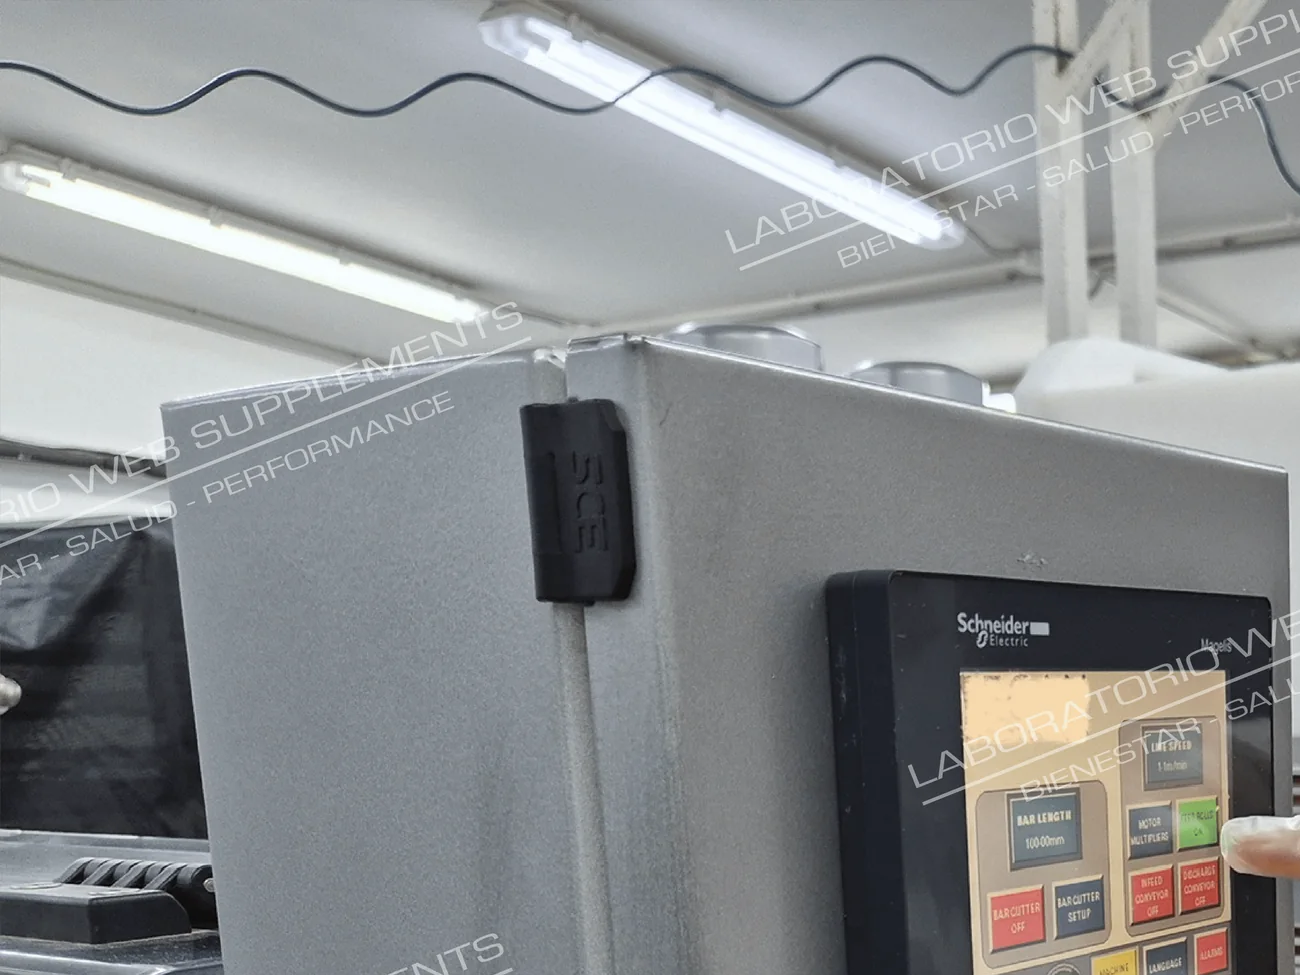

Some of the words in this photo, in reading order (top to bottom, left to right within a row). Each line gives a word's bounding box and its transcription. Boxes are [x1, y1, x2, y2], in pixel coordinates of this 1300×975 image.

[957, 612, 1030, 634] Schneider
[989, 634, 1028, 647] Electric
[1016, 814, 1036, 827] BAR
[1037, 809, 1072, 824] LENGTH
[1138, 817, 1161, 830] MOTOR
[1130, 830, 1169, 846] MULTIPLIERS
[1140, 875, 1163, 889] INFEED
[1183, 879, 1216, 895] CONVEYOR
[1135, 889, 1169, 905] CONVEYOR
[1194, 894, 1206, 906] OFF
[1067, 908, 1092, 923] SETUP
[1146, 906, 1159, 918] OFF
[1010, 921, 1025, 934] OFF
[1149, 956, 1182, 974] LANGUAGE
